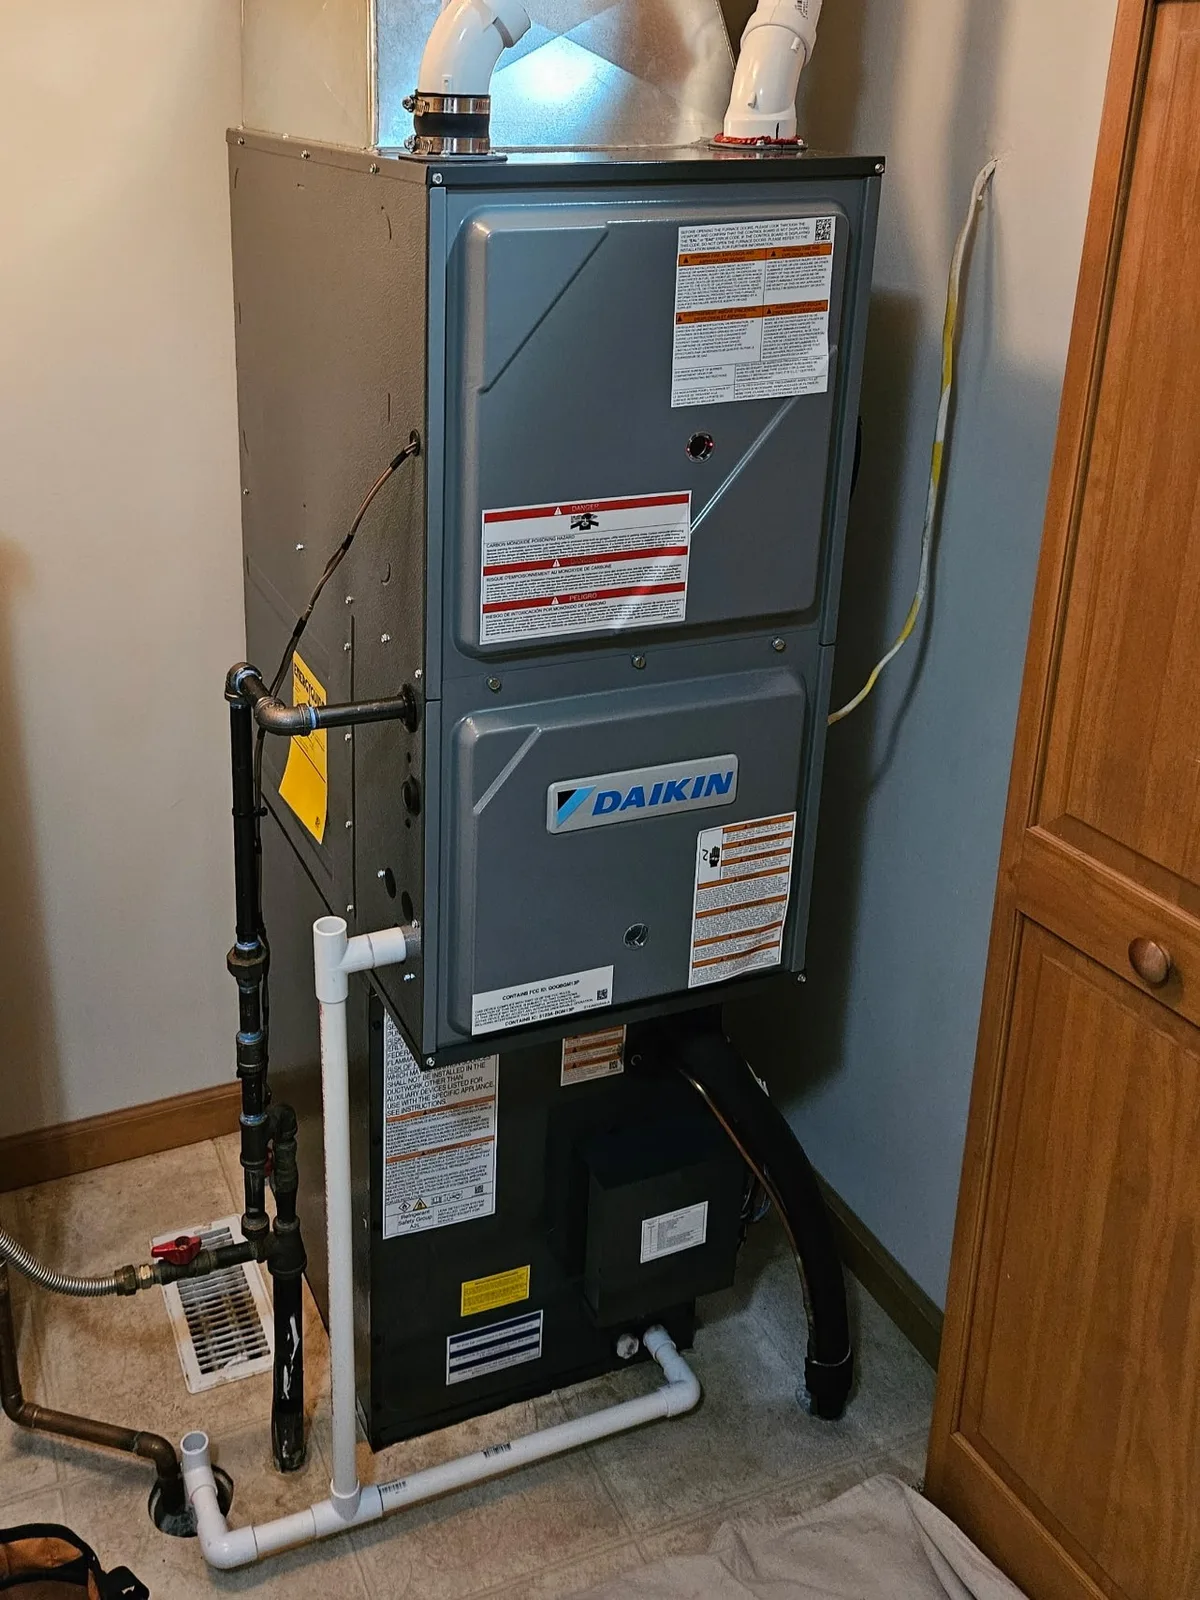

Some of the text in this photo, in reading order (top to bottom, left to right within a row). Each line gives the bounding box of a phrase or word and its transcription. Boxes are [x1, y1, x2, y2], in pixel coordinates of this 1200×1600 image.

[571, 503, 599, 512] DANGER
[569, 593, 597, 601] PELIGRO
[592, 772, 734, 816] DAIKIN
[502, 991, 528, 1001] CONTAINS
[505, 1017, 530, 1026] CONTAINS
[388, 1078, 406, 1088] SHALL
[408, 1075, 421, 1083] NOT
[432, 1066, 465, 1079] INSTALLED
[474, 1062, 486, 1070] THE
[425, 1077, 446, 1087] OTHER
[447, 1074, 464, 1082] THAN
[388, 1076, 483, 1102] AUXILIARY DEVICES LISTED FOR
[388, 1101, 400, 1110] USE
[401, 1097, 417, 1106] WITH
[419, 1094, 430, 1103] THE
[432, 1088, 460, 1100] SPECIFIC
[388, 1108, 400, 1117] SEE
